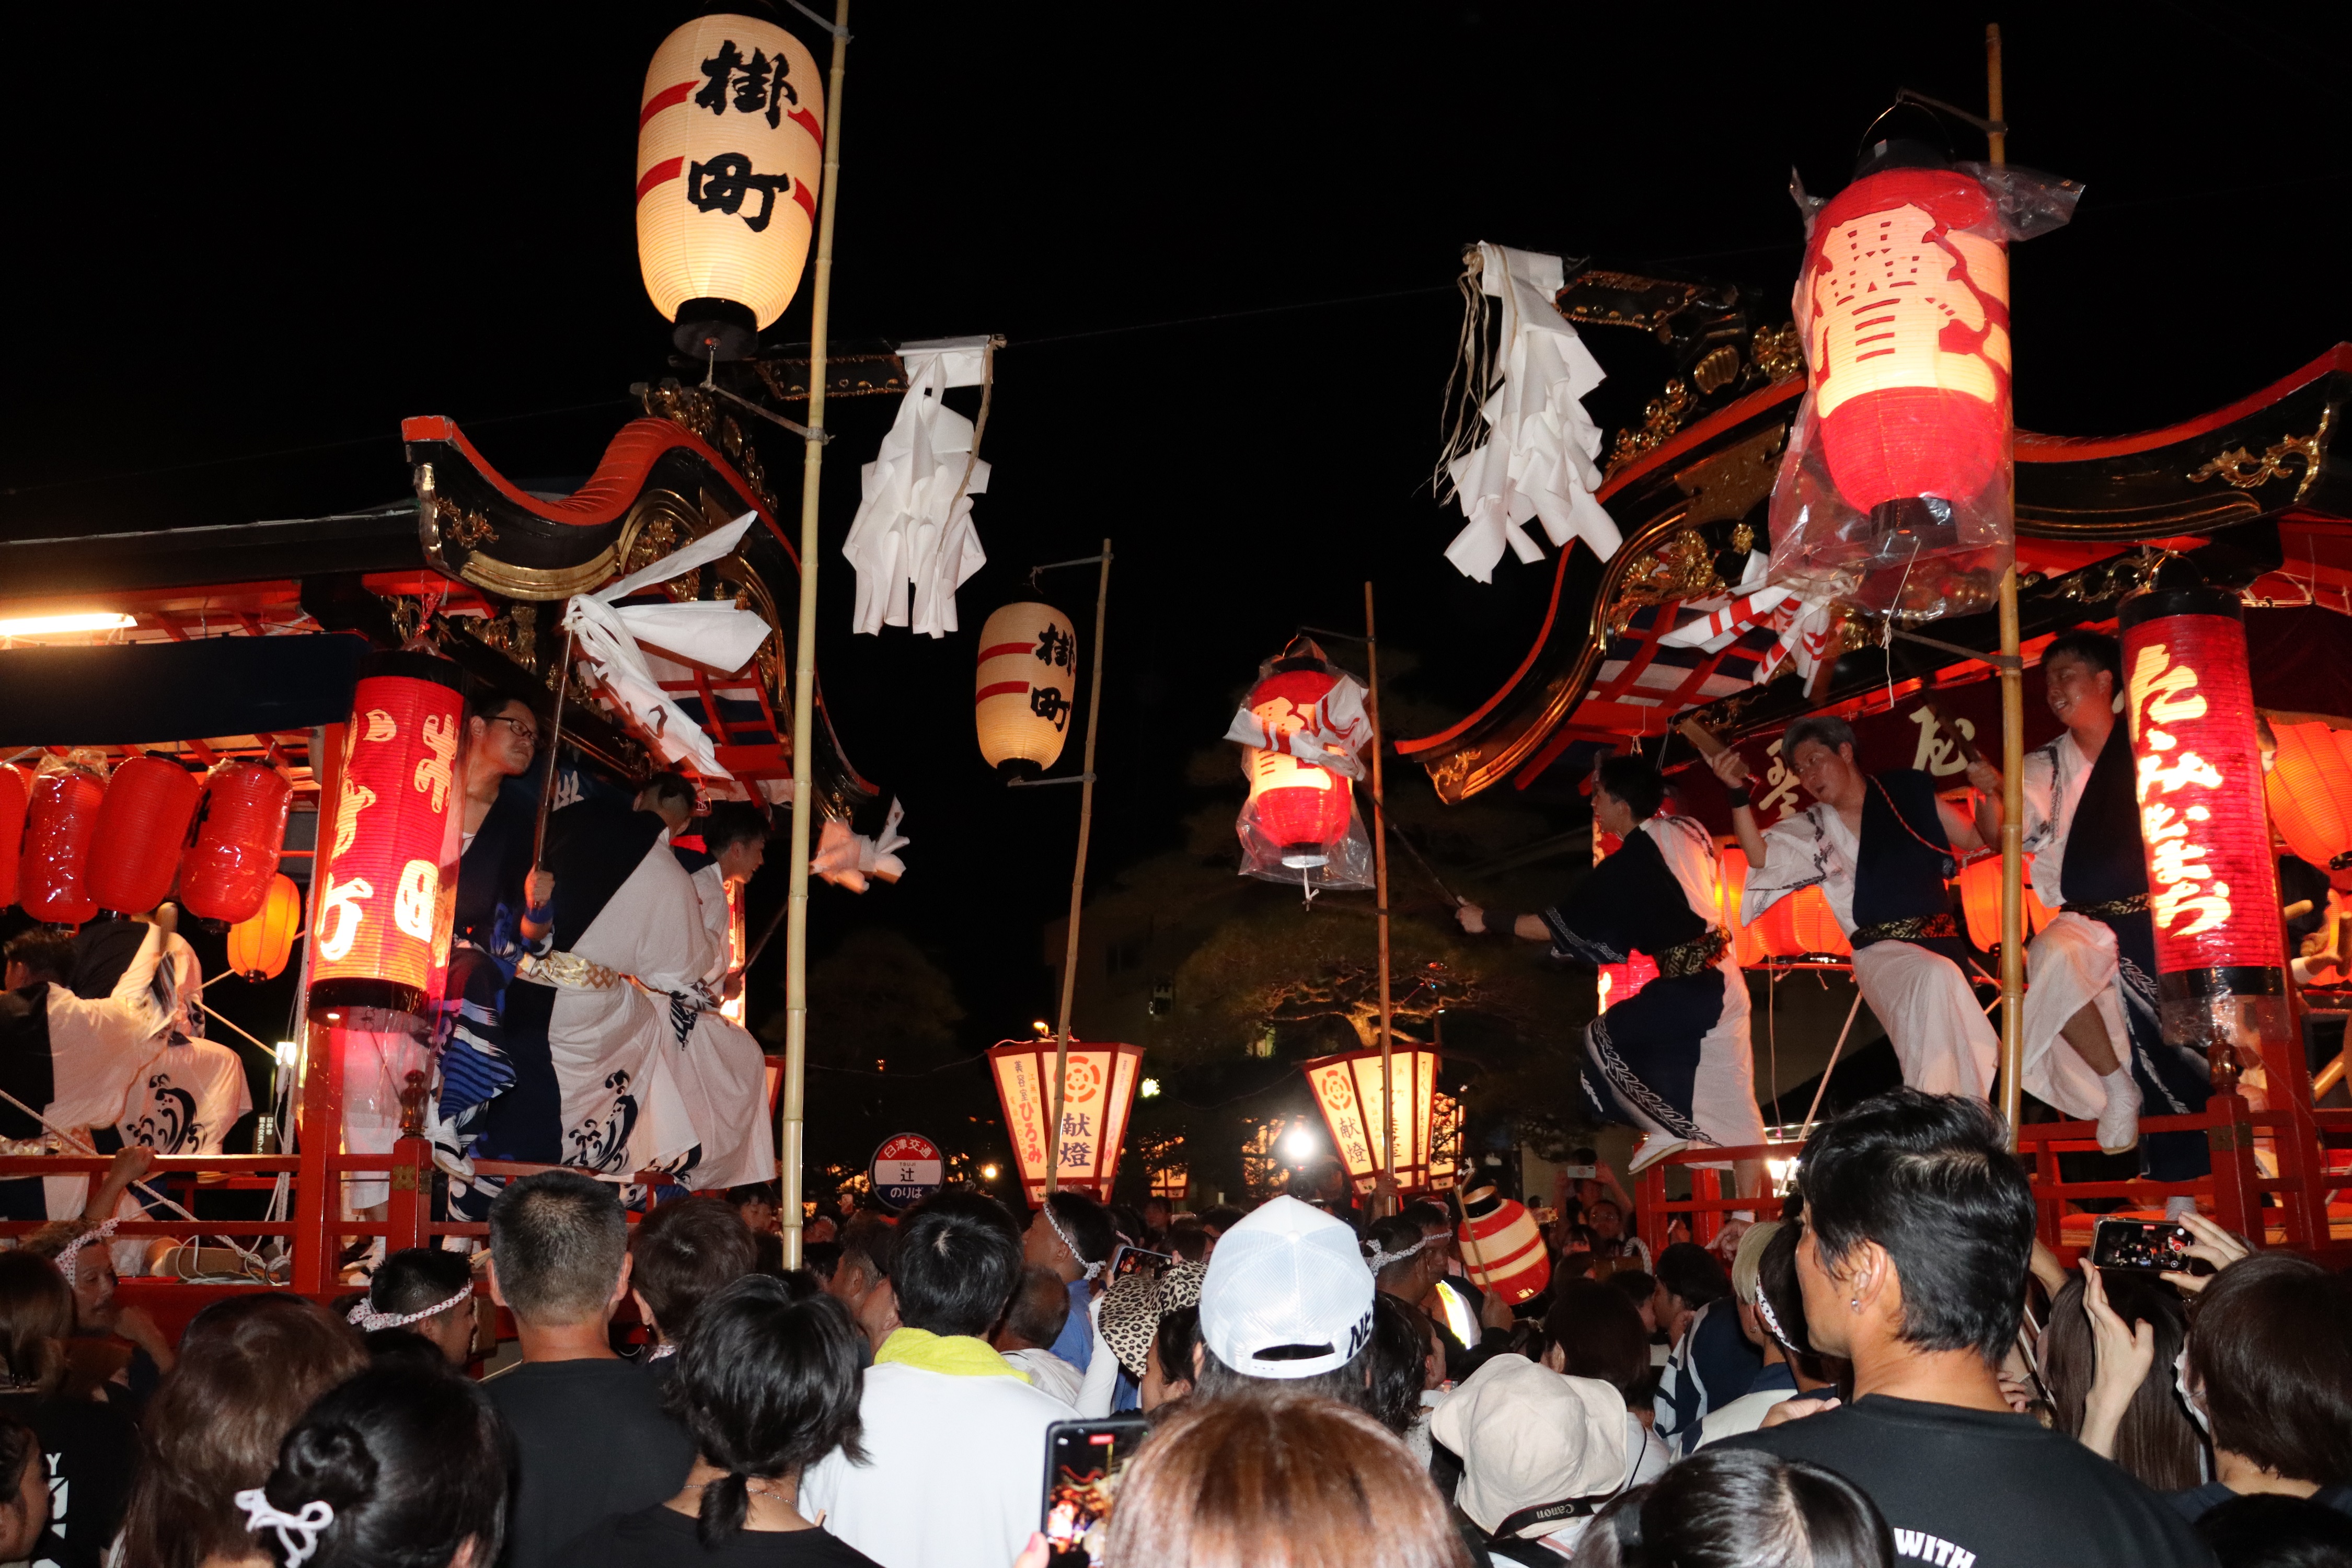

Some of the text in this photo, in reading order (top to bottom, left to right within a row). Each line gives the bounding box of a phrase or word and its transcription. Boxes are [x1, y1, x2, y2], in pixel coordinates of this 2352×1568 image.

[687, 40, 797, 232] 掛町
[1031, 622, 1075, 732] 掛町
[1058, 1113, 1092, 1167] 献燈
[1339, 1116, 1367, 1163] 献燈
[890, 1187, 924, 1198] のりば
[901, 1168, 914, 1182] 辻
[1536, 1504, 1575, 1519] Canon
[1894, 1527, 1977, 1568] WITH
